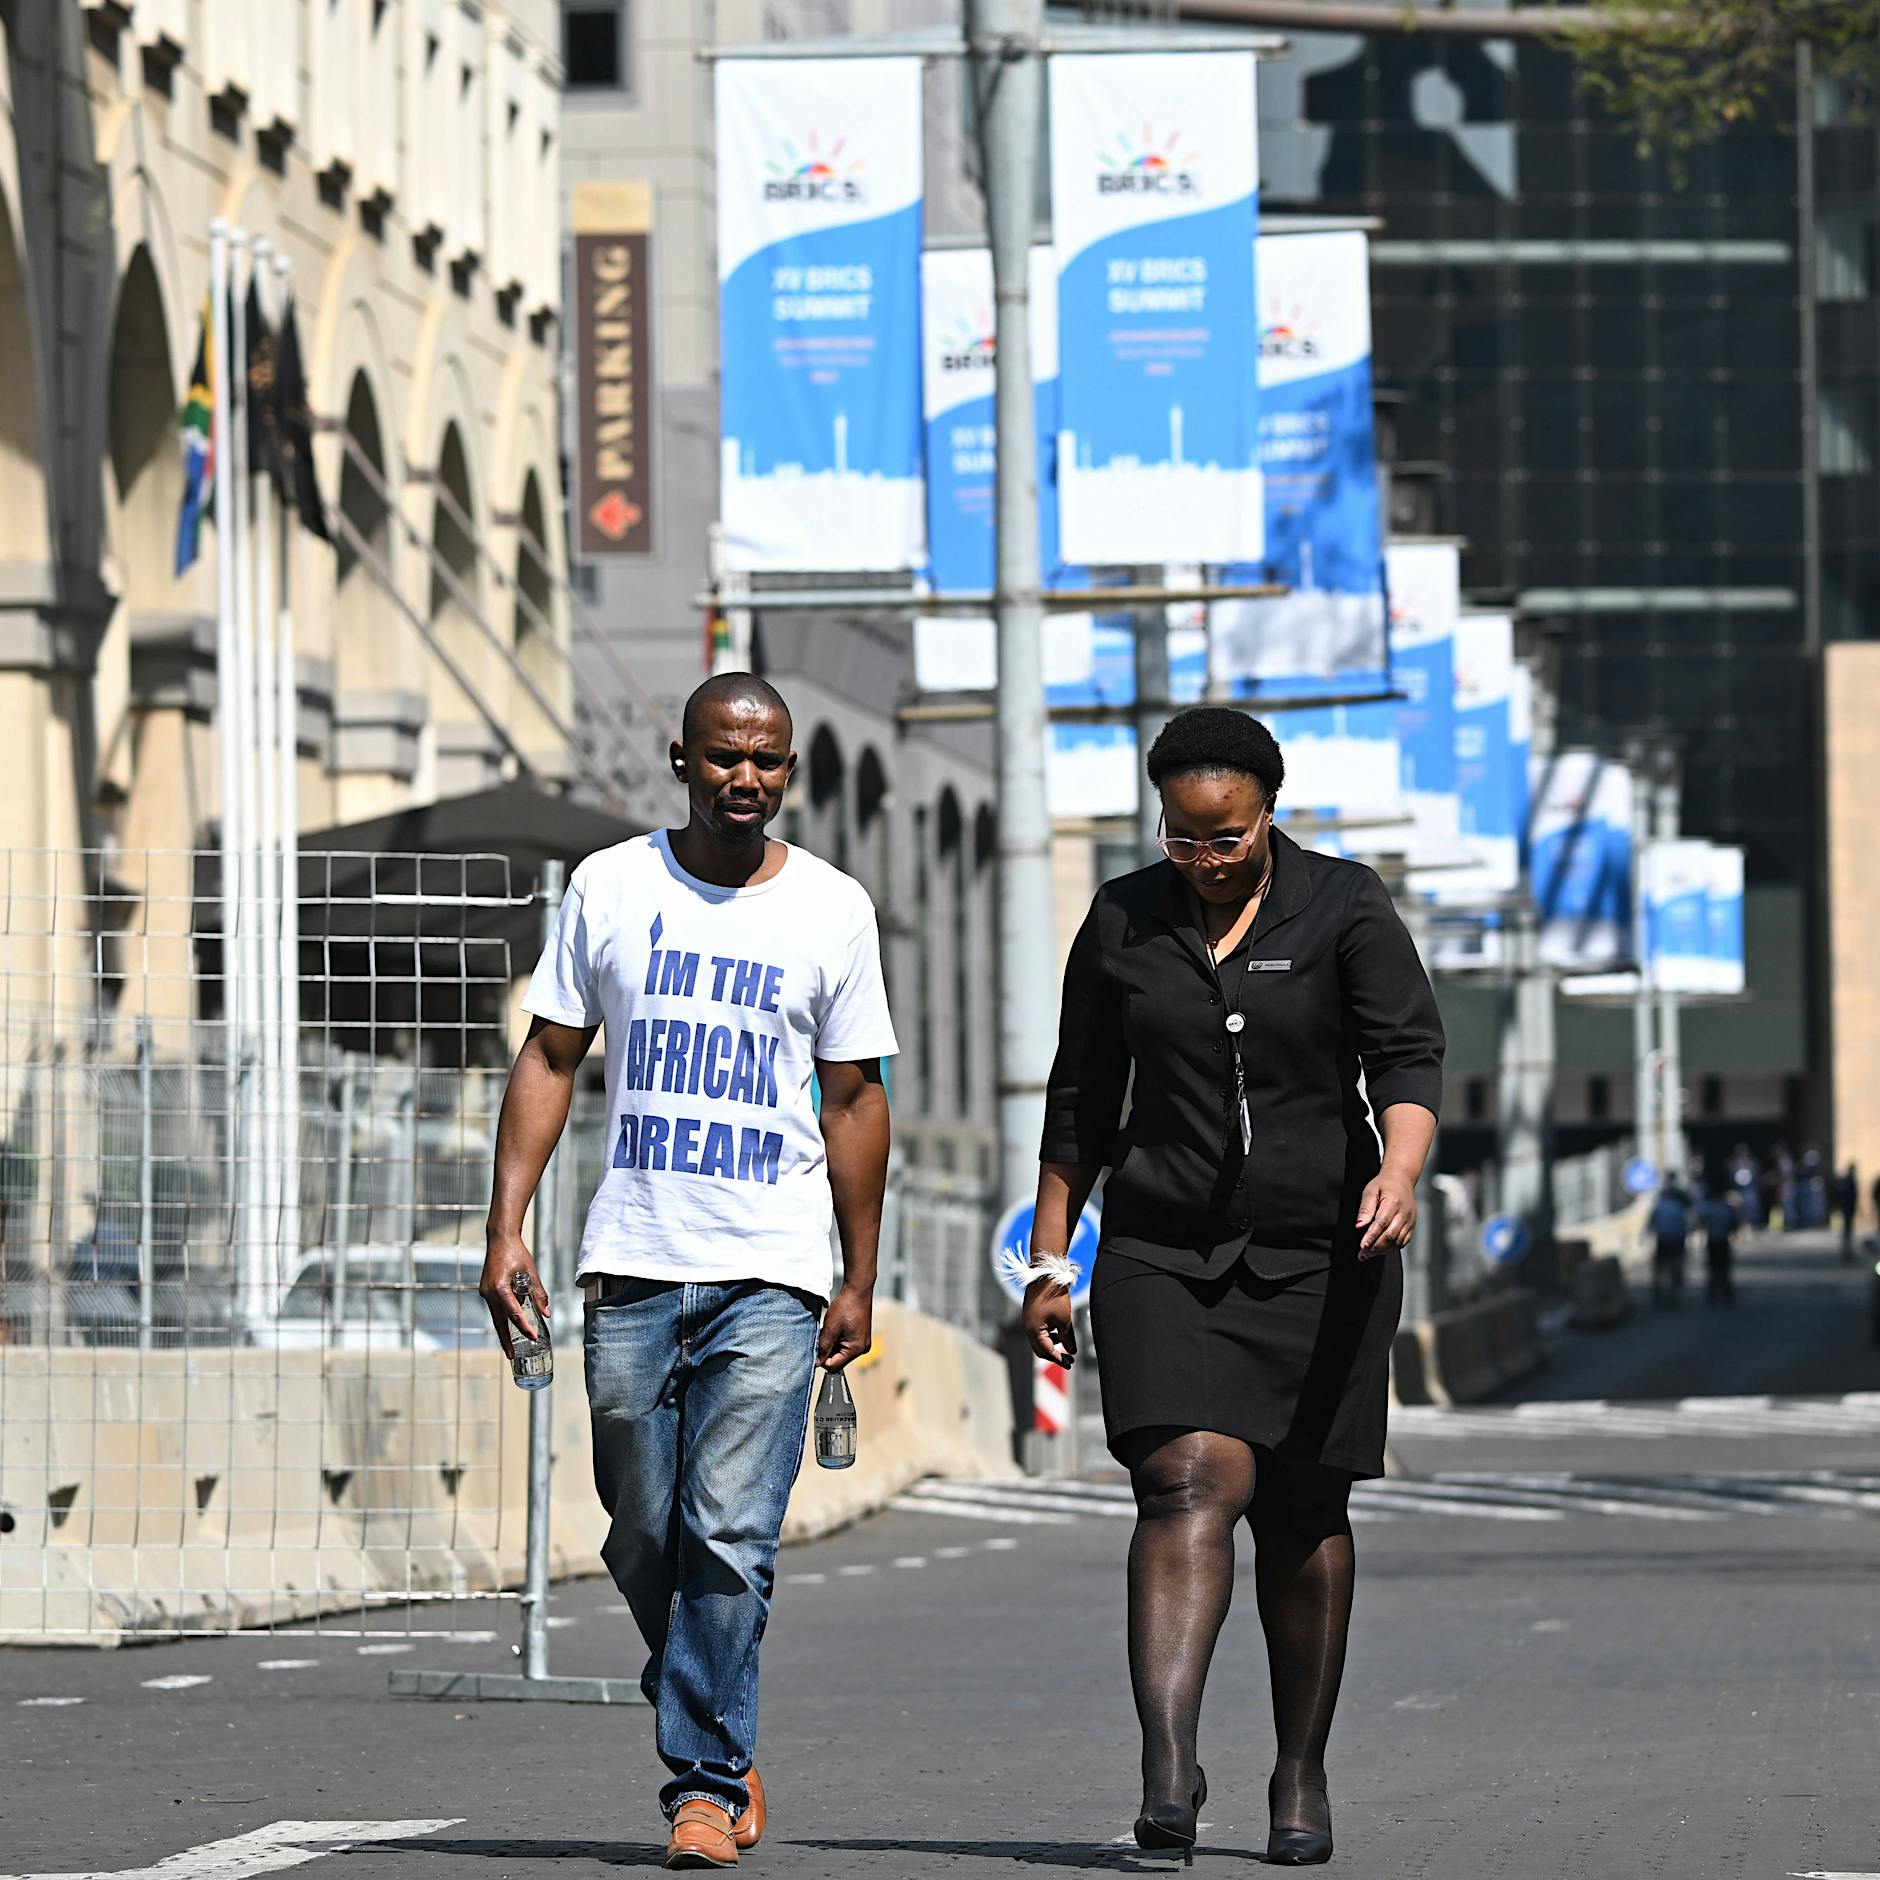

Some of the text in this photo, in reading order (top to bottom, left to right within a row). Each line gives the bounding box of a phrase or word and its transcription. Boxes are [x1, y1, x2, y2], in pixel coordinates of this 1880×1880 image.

[774, 264, 872, 291] XV BRICS
[1107, 257, 1207, 284] XV BRICS
[774, 295, 869, 320] SUMMIT
[1108, 287, 1204, 314] SUMMIT
[593, 245, 633, 480] PARKING
[711, 956, 785, 1014] THE
[626, 1018, 779, 1108] AFRICAN
[613, 1114, 784, 1185] DREAM
